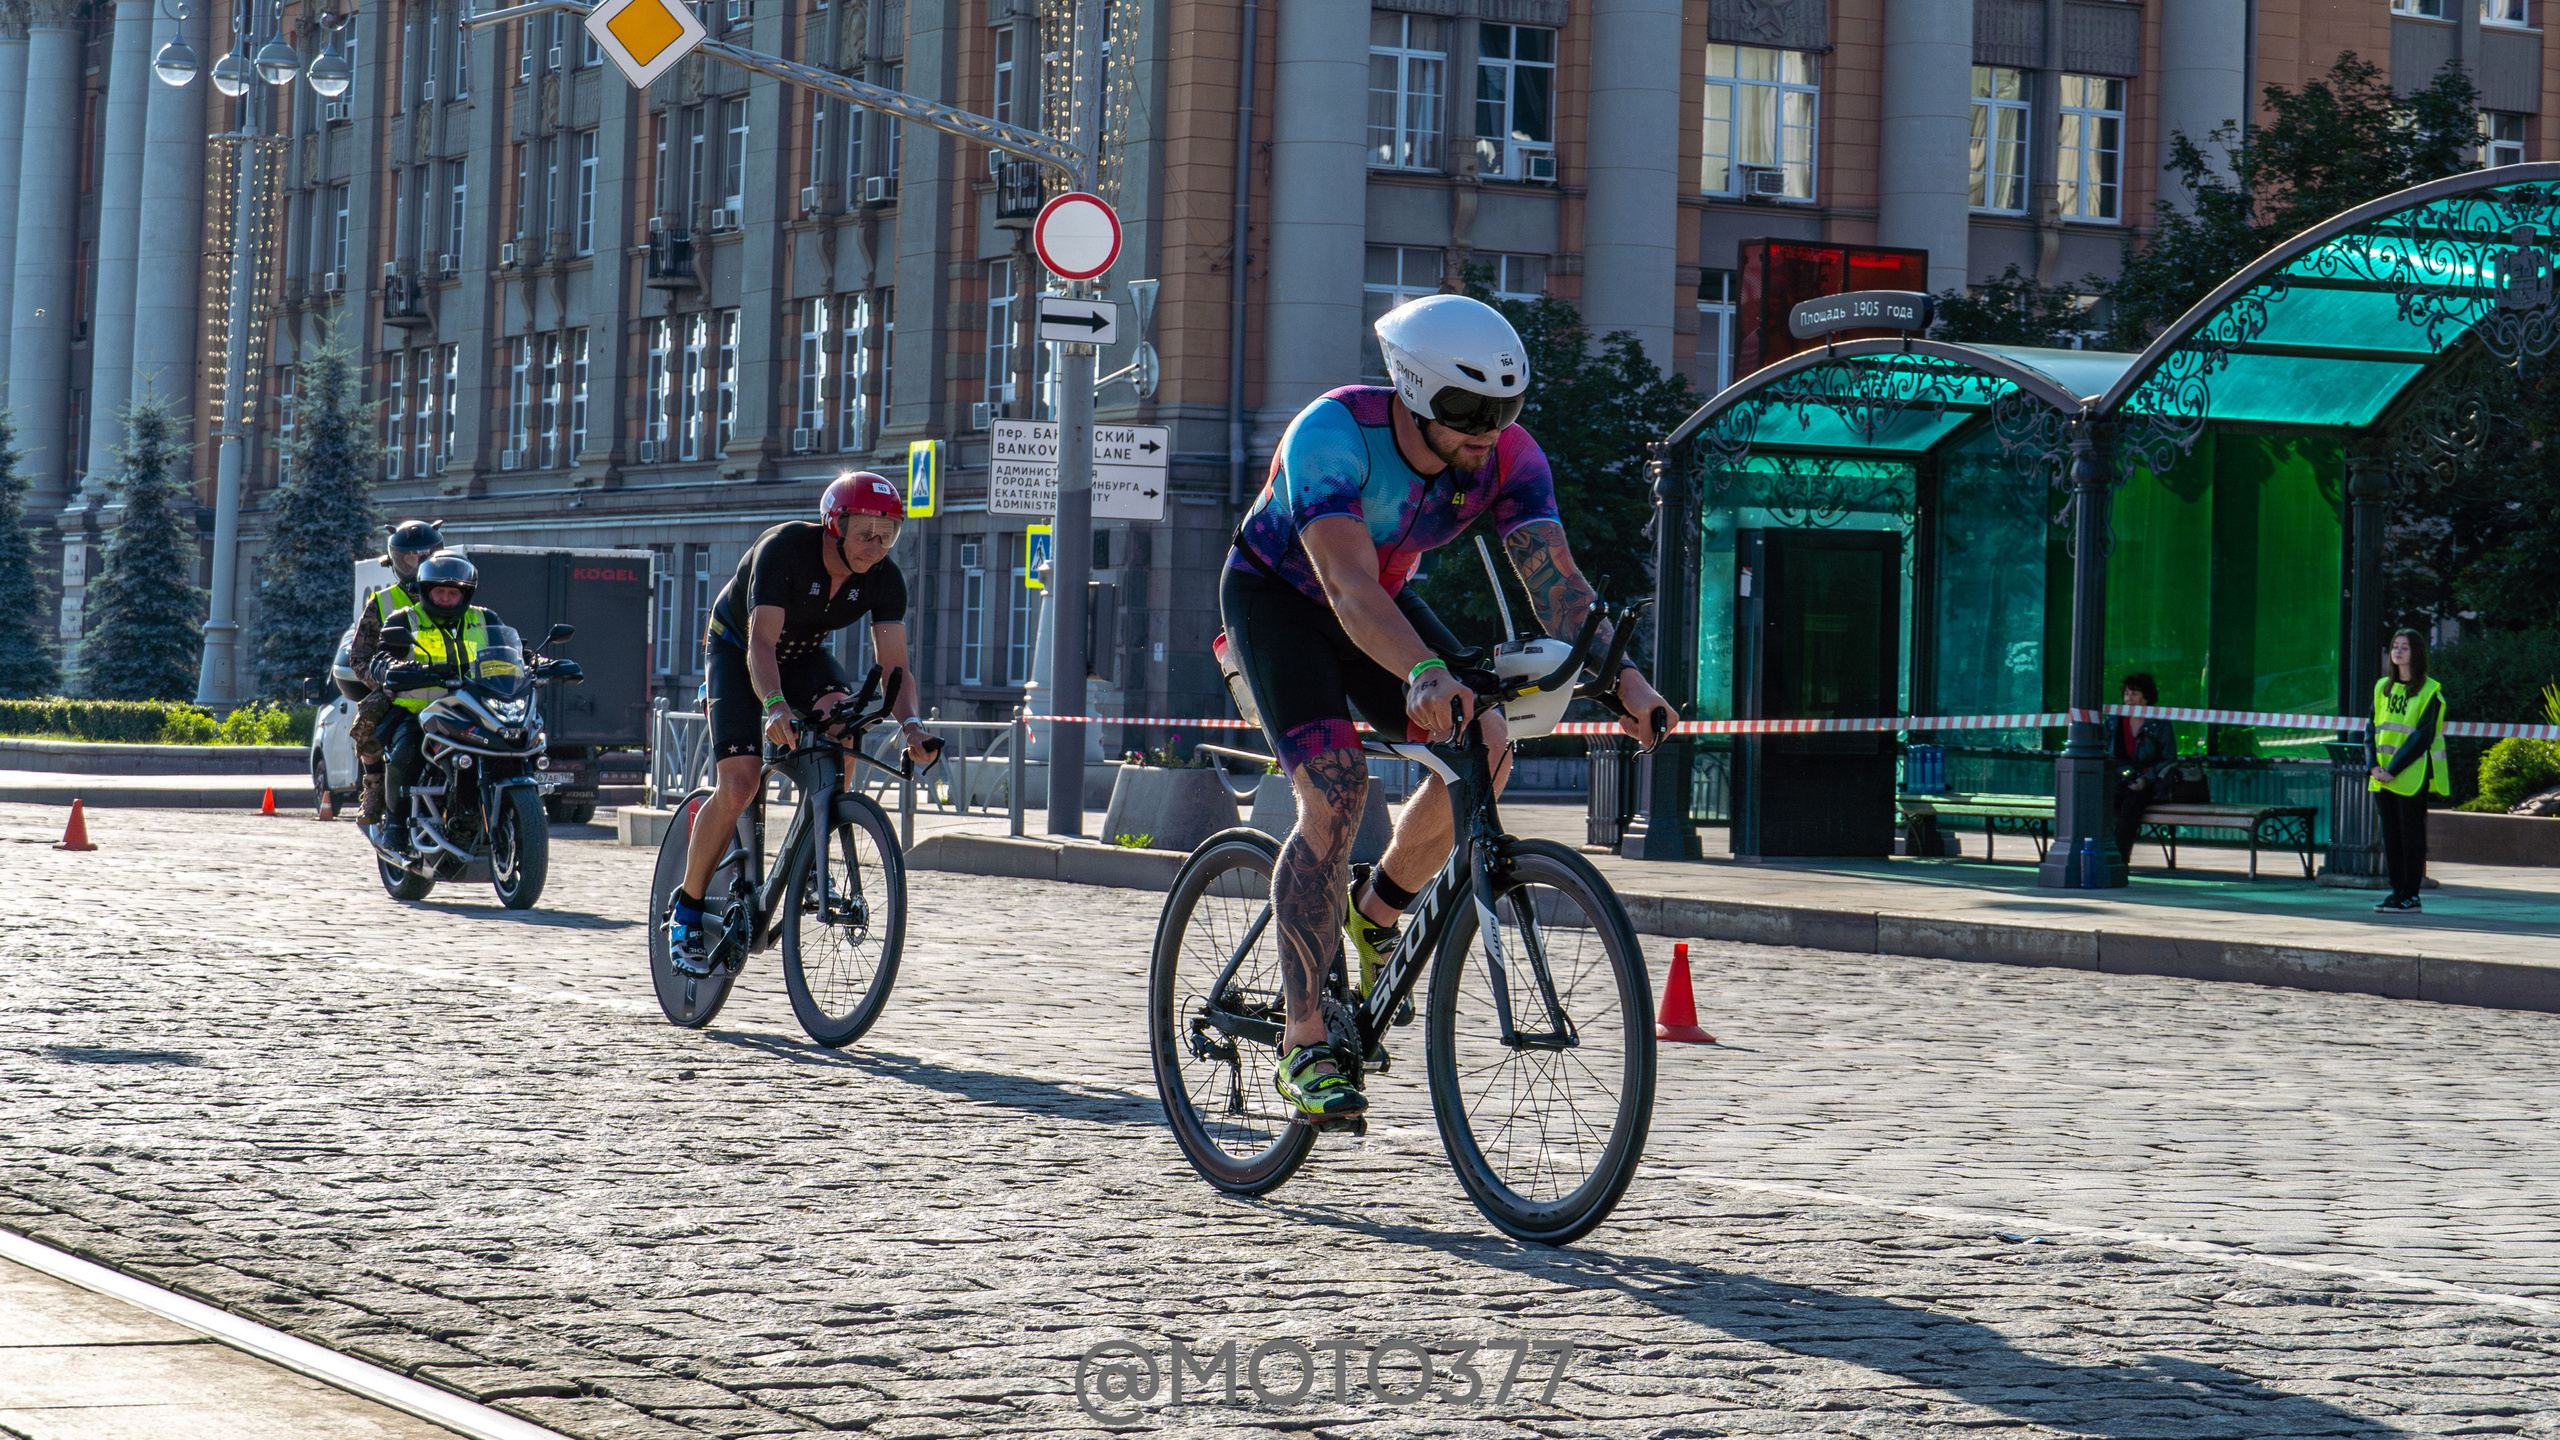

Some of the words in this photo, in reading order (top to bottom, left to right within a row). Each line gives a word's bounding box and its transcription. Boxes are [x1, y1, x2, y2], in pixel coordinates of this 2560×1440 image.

[1800, 307, 1846, 327] Площадь
[1853, 301, 1880, 317] 1905
[1886, 305, 1913, 320] года
[1500, 357, 1514, 367] 164
[1395, 359, 1424, 388] SMITH
[997, 428, 1027, 440] пер.
[997, 442, 1058, 456] BANKOV
[1094, 446, 1132, 460] LANE
[995, 476, 1041, 487] ГОРОДА
[994, 488, 1057, 500] EKATERINB
[1092, 493, 1110, 502] ITY
[994, 499, 1057, 511] ADMINISTR
[1370, 843, 1461, 1030] SCOTT
[1489, 915, 1502, 961] SCOTT
[1378, 994, 1406, 1045] SCOTT
